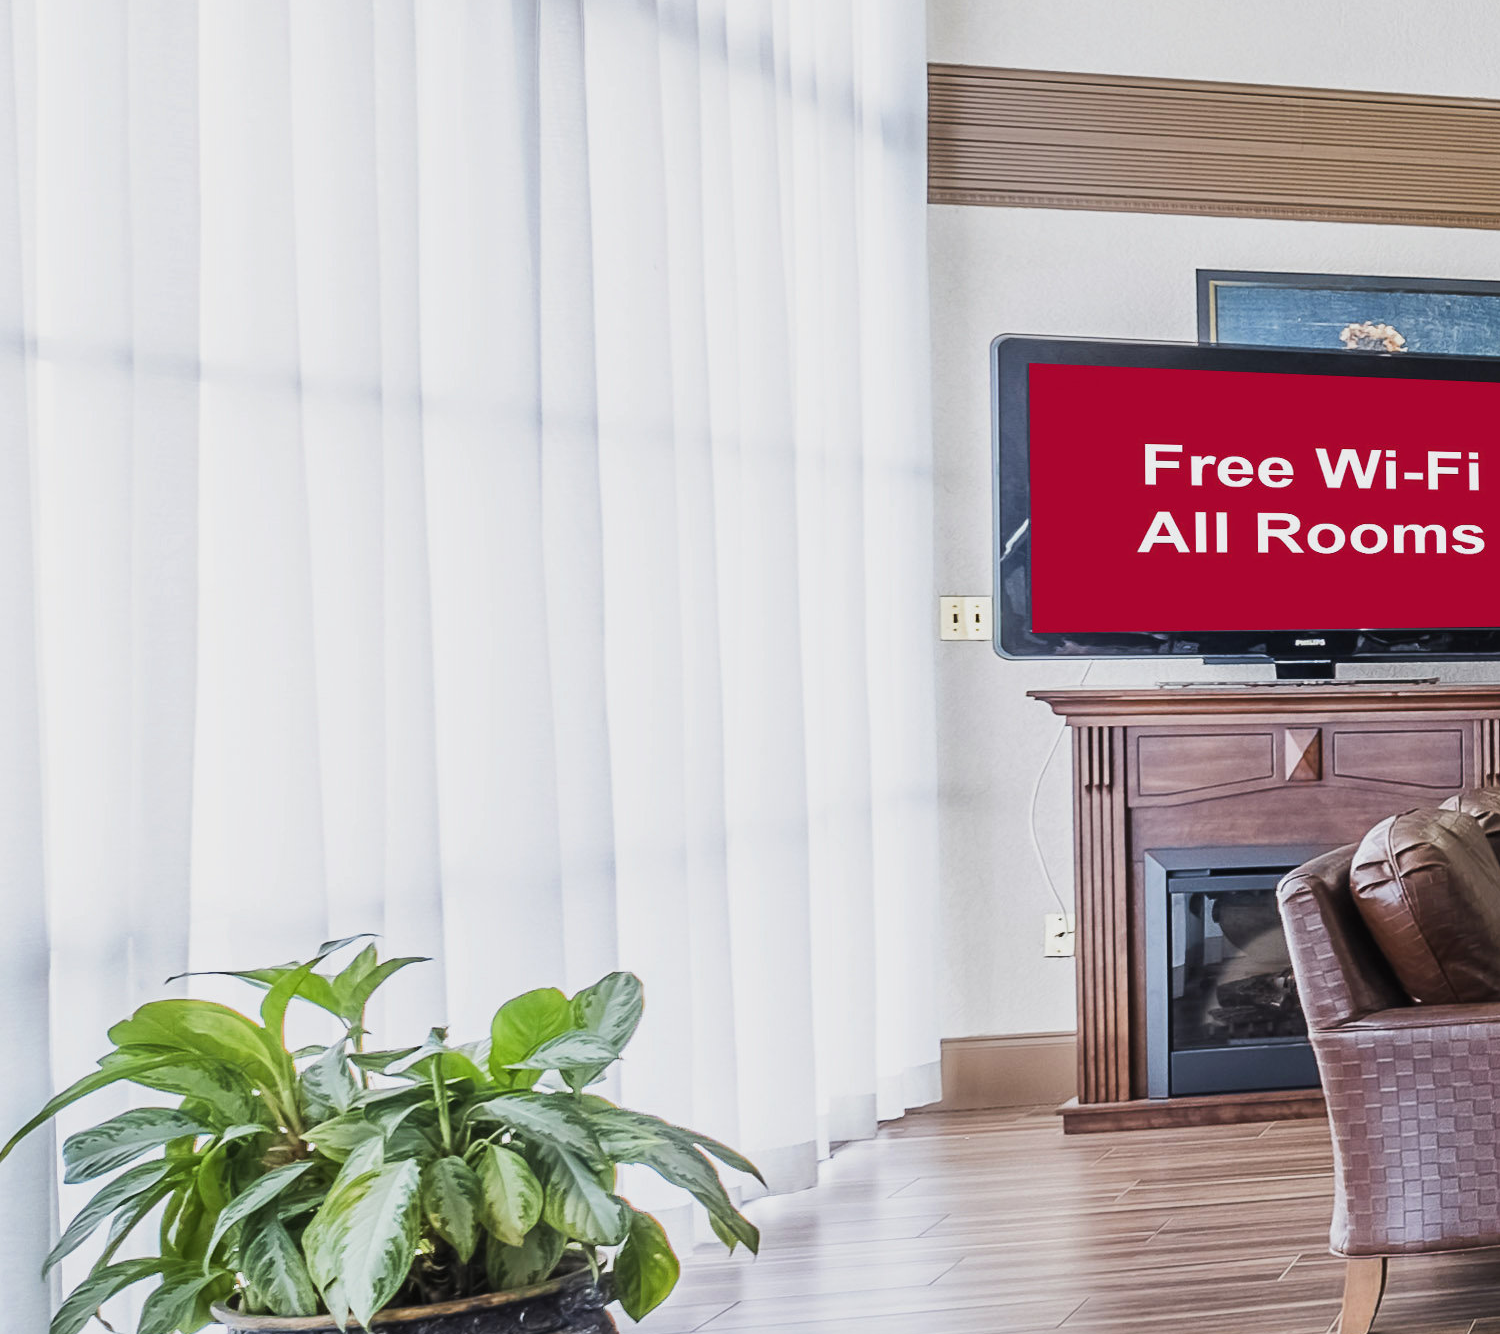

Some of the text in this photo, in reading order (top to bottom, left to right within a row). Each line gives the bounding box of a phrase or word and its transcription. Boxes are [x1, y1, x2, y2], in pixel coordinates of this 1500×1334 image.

[1144, 443, 1480, 491] Free Wi-Fi
[1136, 511, 1485, 555] All Rooms
